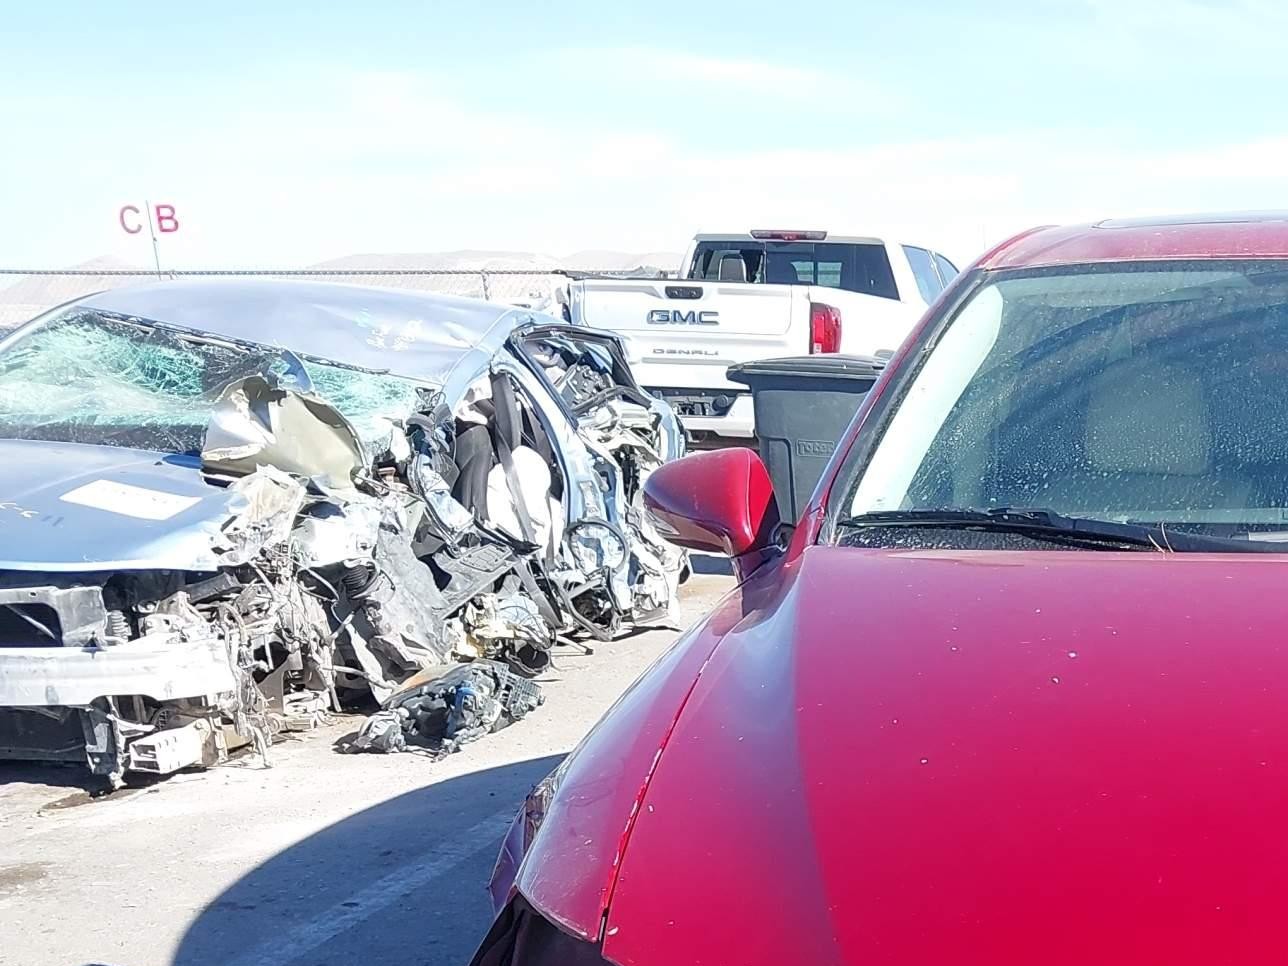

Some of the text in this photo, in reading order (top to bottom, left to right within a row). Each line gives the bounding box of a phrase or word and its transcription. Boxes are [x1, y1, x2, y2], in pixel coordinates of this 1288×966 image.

[120, 204, 179, 234] C B
[647, 309, 720, 326] GMC
